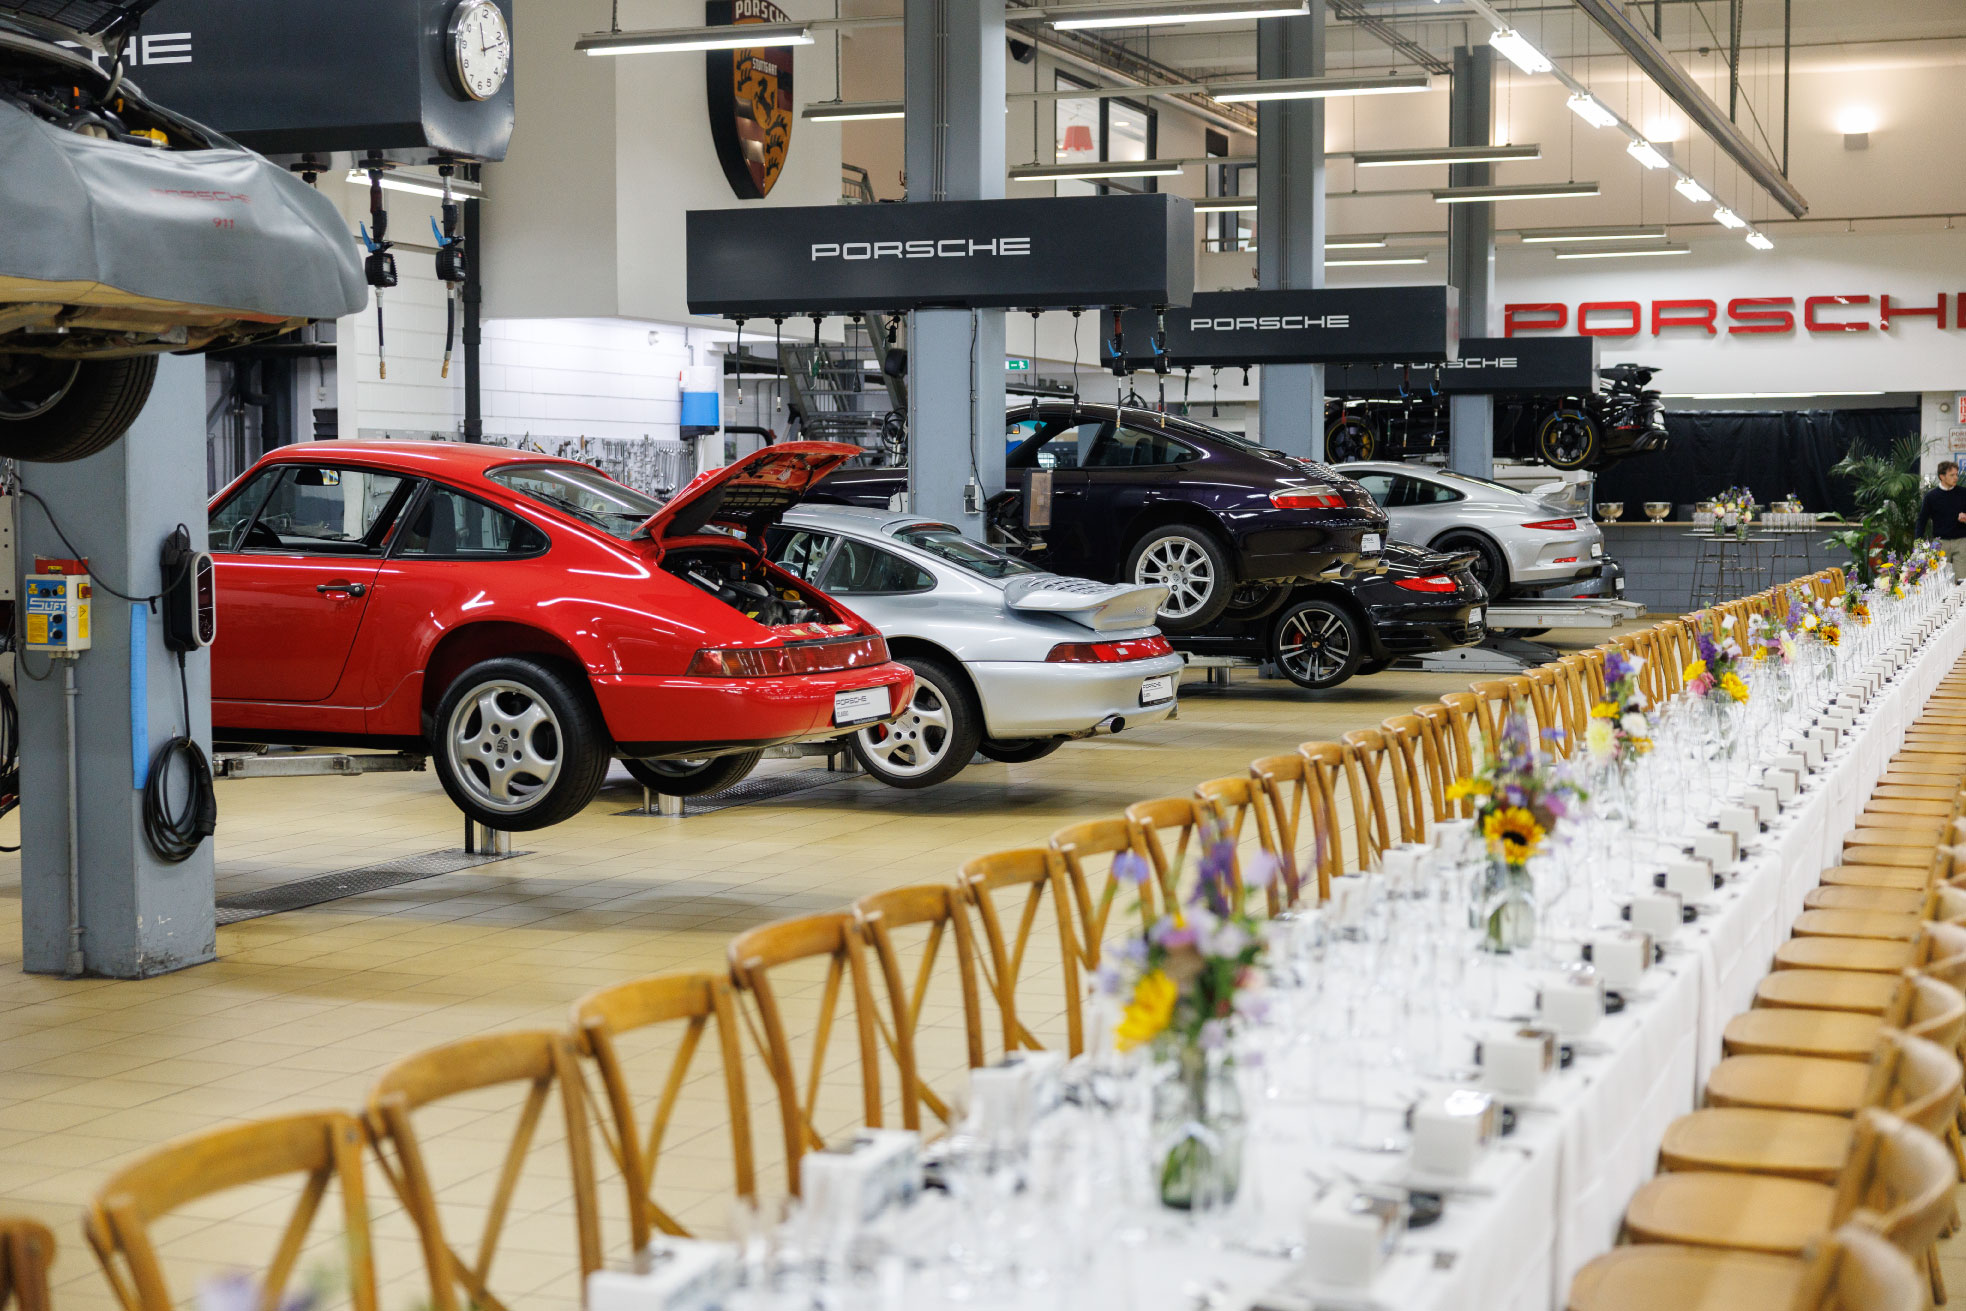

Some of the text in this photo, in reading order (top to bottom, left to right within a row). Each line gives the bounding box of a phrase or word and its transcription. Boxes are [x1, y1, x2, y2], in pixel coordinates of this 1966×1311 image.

[482, 9, 489, 19] 12
[736, 0, 790, 23] PORSCH
[466, 23, 472, 33] 10
[496, 32, 502, 40] 2
[53, 32, 192, 66] HE
[461, 40, 467, 49] 9
[463, 59, 469, 69] 8
[469, 74, 474, 83] 7
[486, 78, 492, 87] 5
[477, 81, 483, 90] 6
[212, 217, 235, 230] 911
[811, 237, 1031, 261] PORSCHE
[1504, 293, 1966, 338] PORSCH
[1190, 315, 1350, 331] PORSCHE
